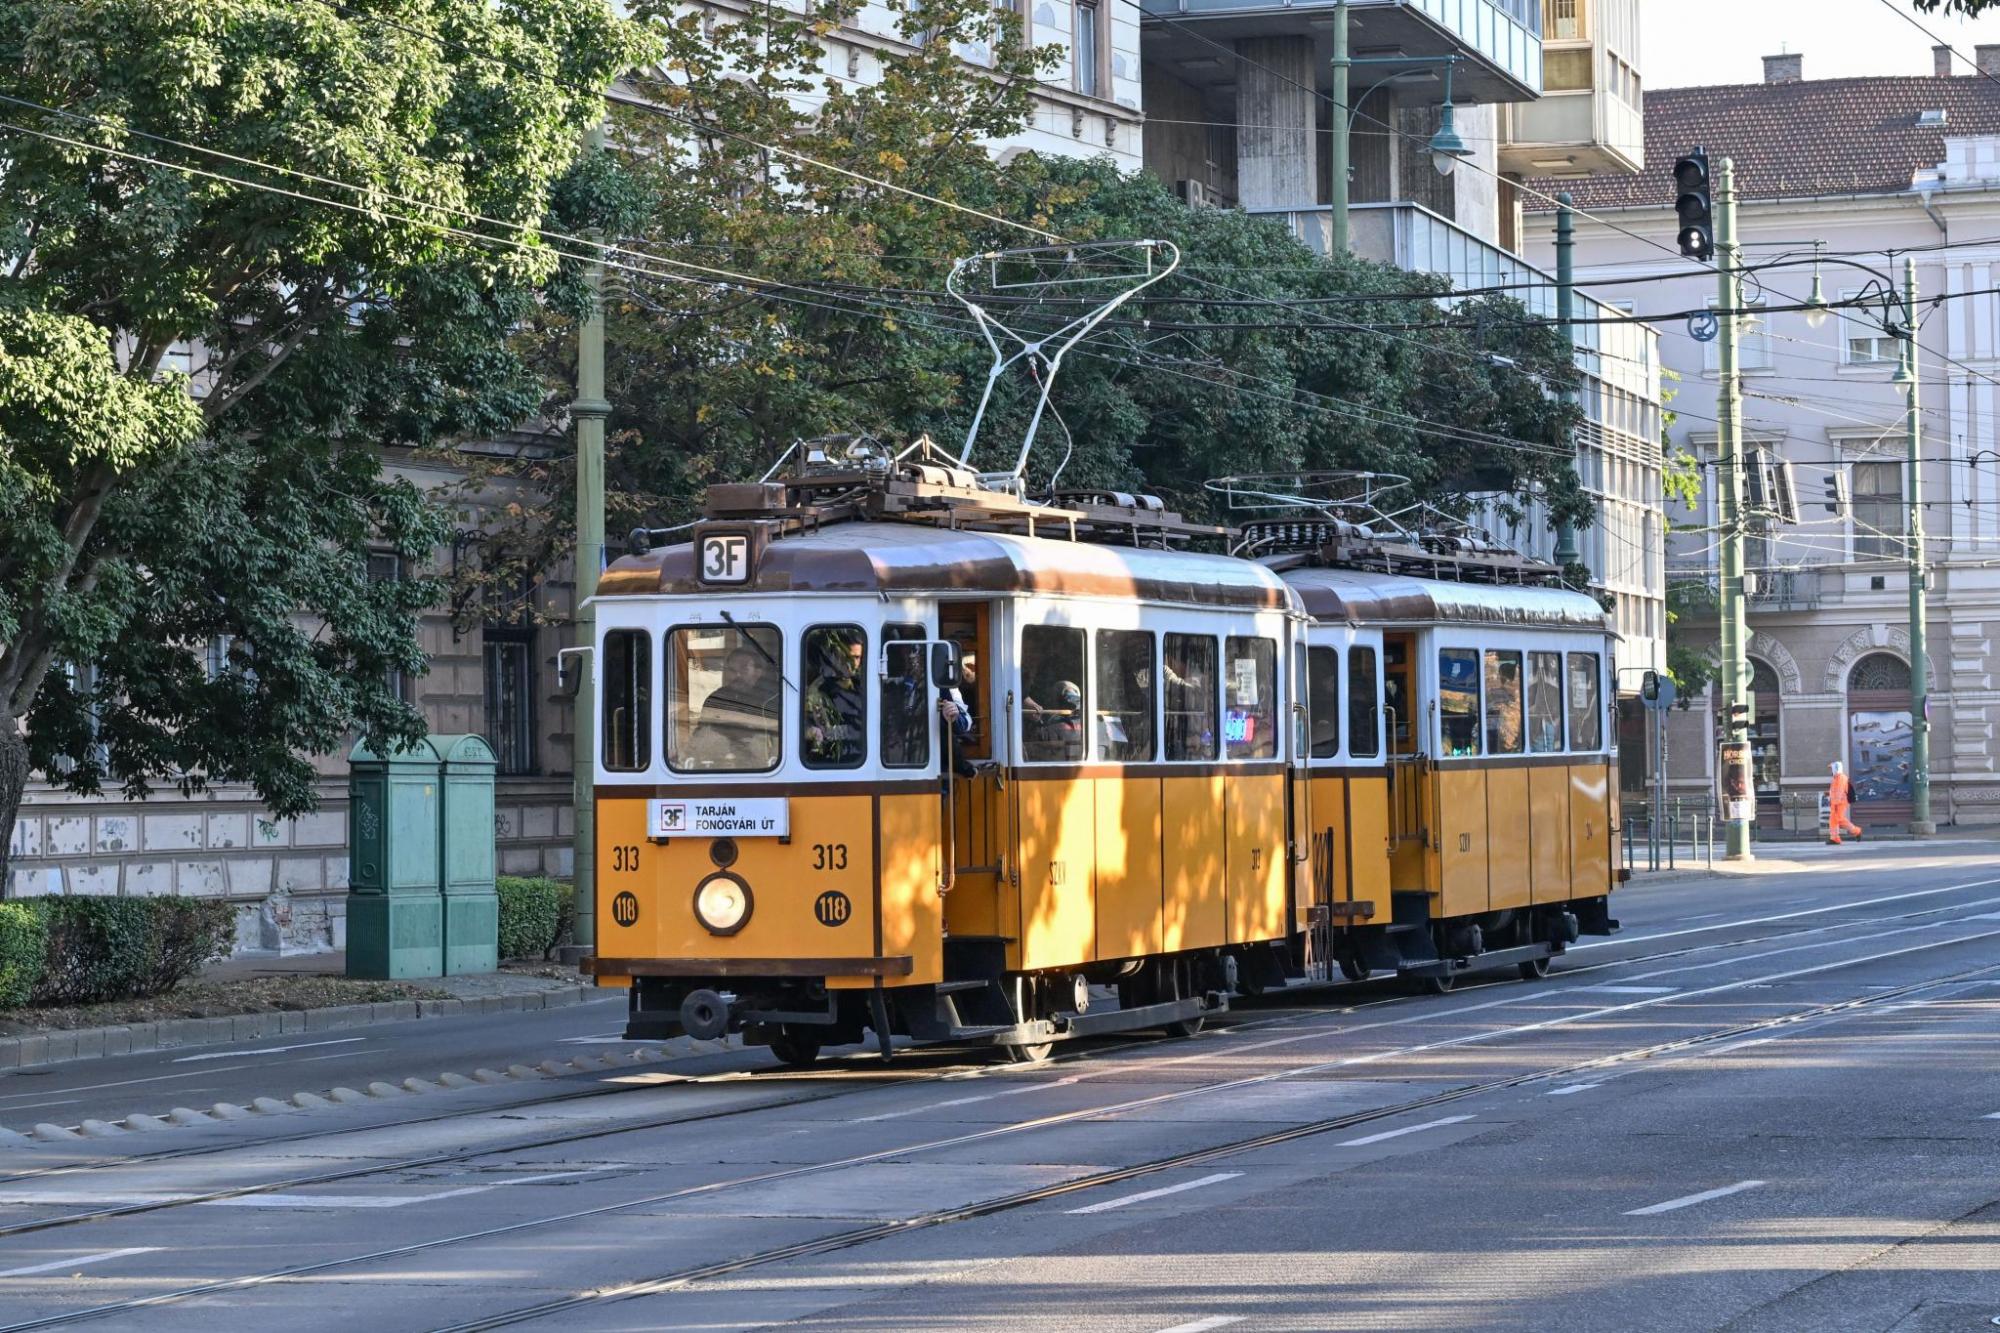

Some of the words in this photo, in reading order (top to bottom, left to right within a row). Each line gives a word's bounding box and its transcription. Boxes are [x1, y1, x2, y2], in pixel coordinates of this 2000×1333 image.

[706, 539, 745, 577] 3F
[663, 808, 683, 827] 3F
[695, 802, 736, 817] TARJÁN
[695, 816, 756, 830] FONÓGYÁRI
[761, 816, 775, 830] ÚT
[612, 845, 640, 872] 313
[812, 843, 848, 871] 313
[616, 897, 636, 922] 118
[819, 896, 847, 922] 118
